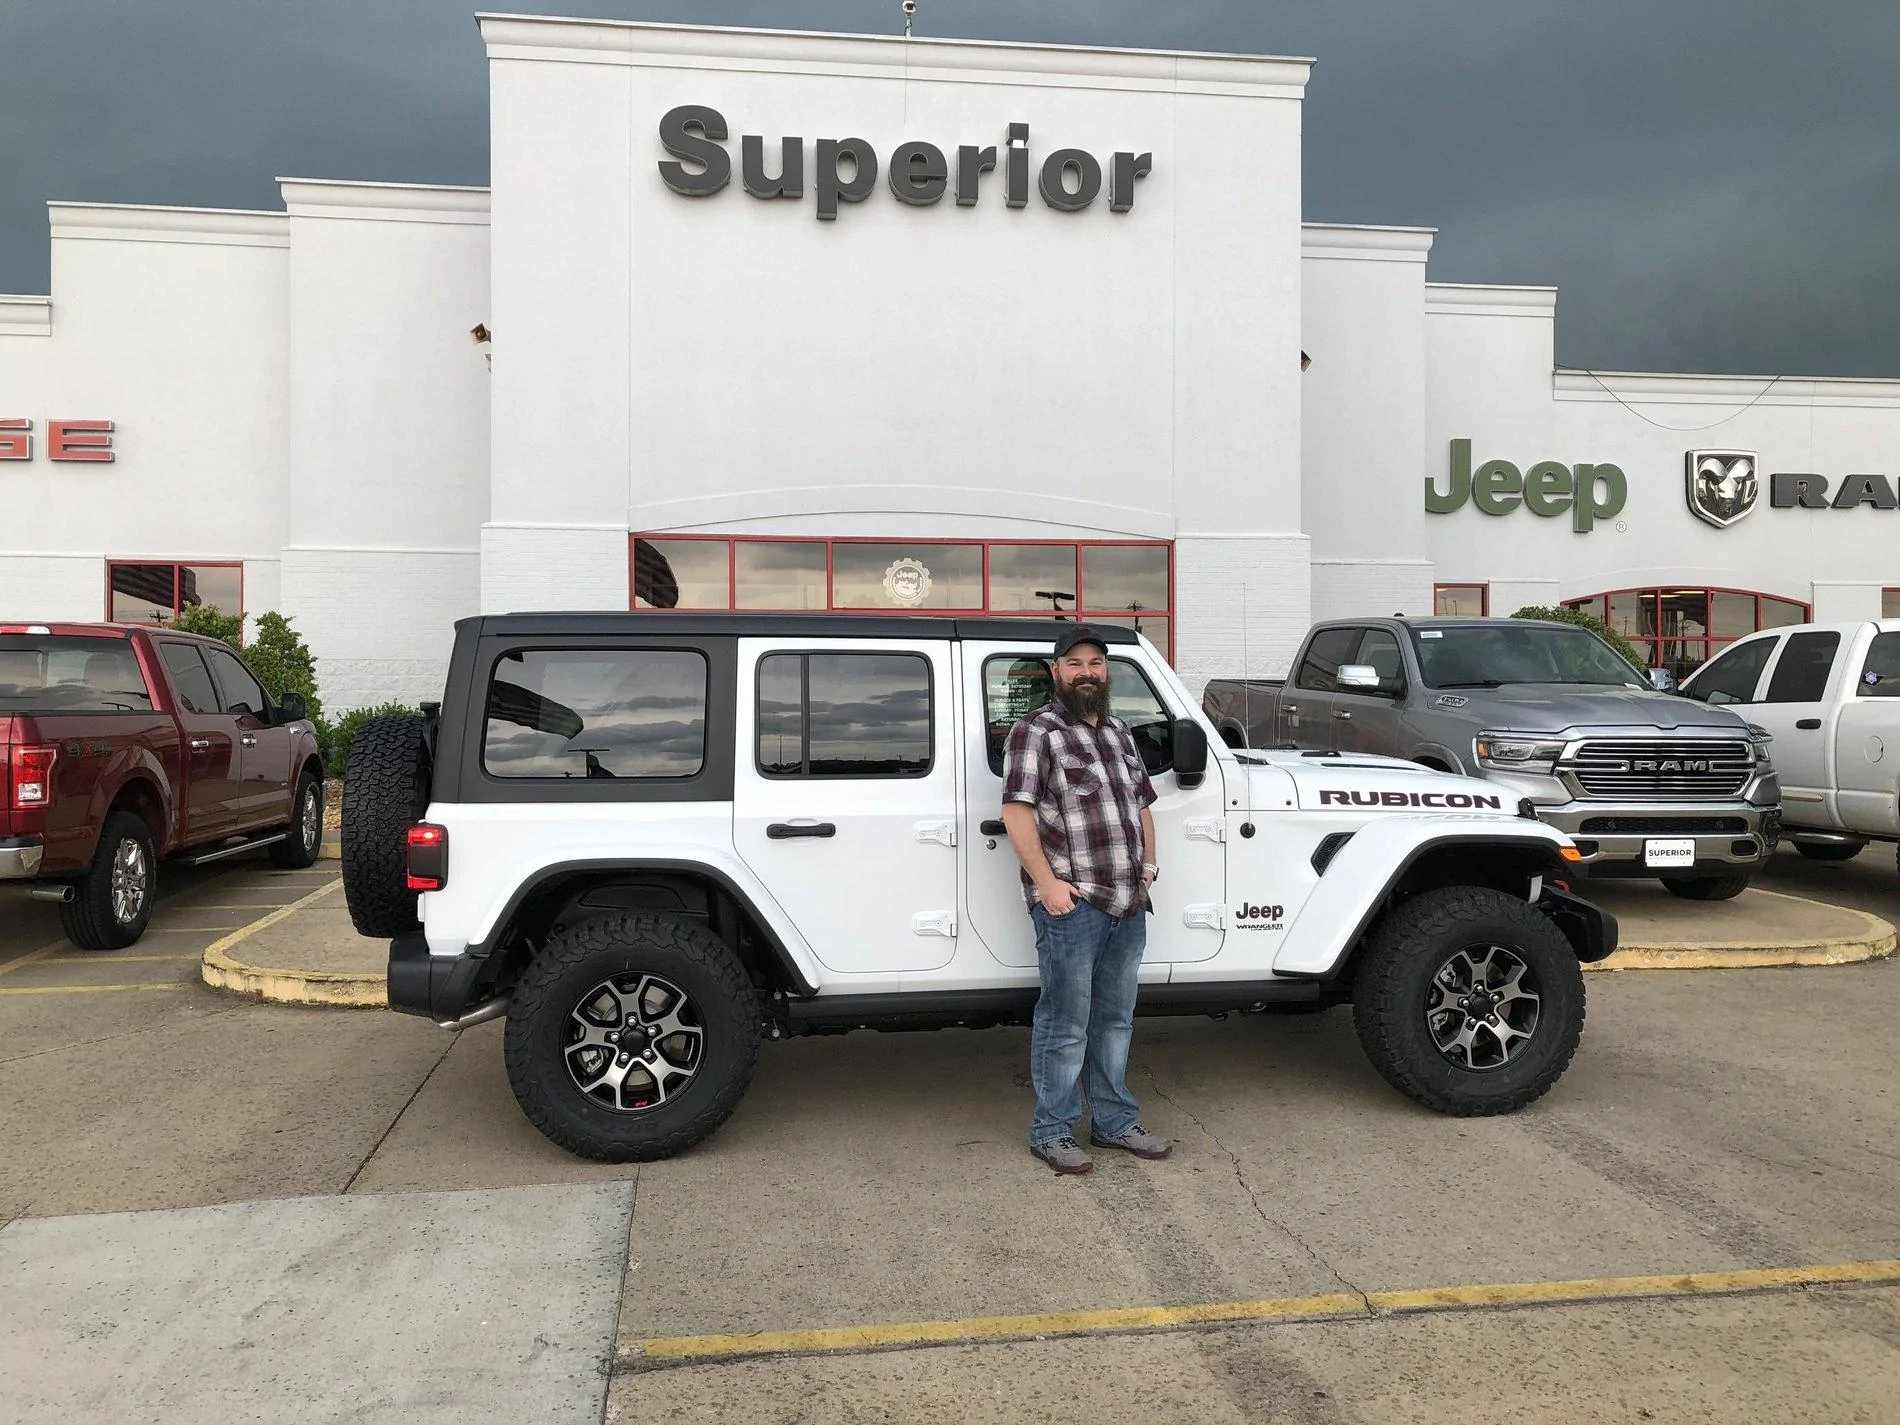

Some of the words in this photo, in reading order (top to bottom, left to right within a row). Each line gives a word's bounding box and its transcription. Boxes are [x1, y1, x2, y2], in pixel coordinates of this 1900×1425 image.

[658, 105, 1152, 219] Superior
[1425, 438, 1627, 532] Jeep
[1770, 473, 1900, 508] RA
[1634, 760, 1706, 771] RAM
[1319, 790, 1501, 809] RUBICON
[1648, 849, 1692, 857] SUPERIOR
[1235, 902, 1284, 921] Jeep
